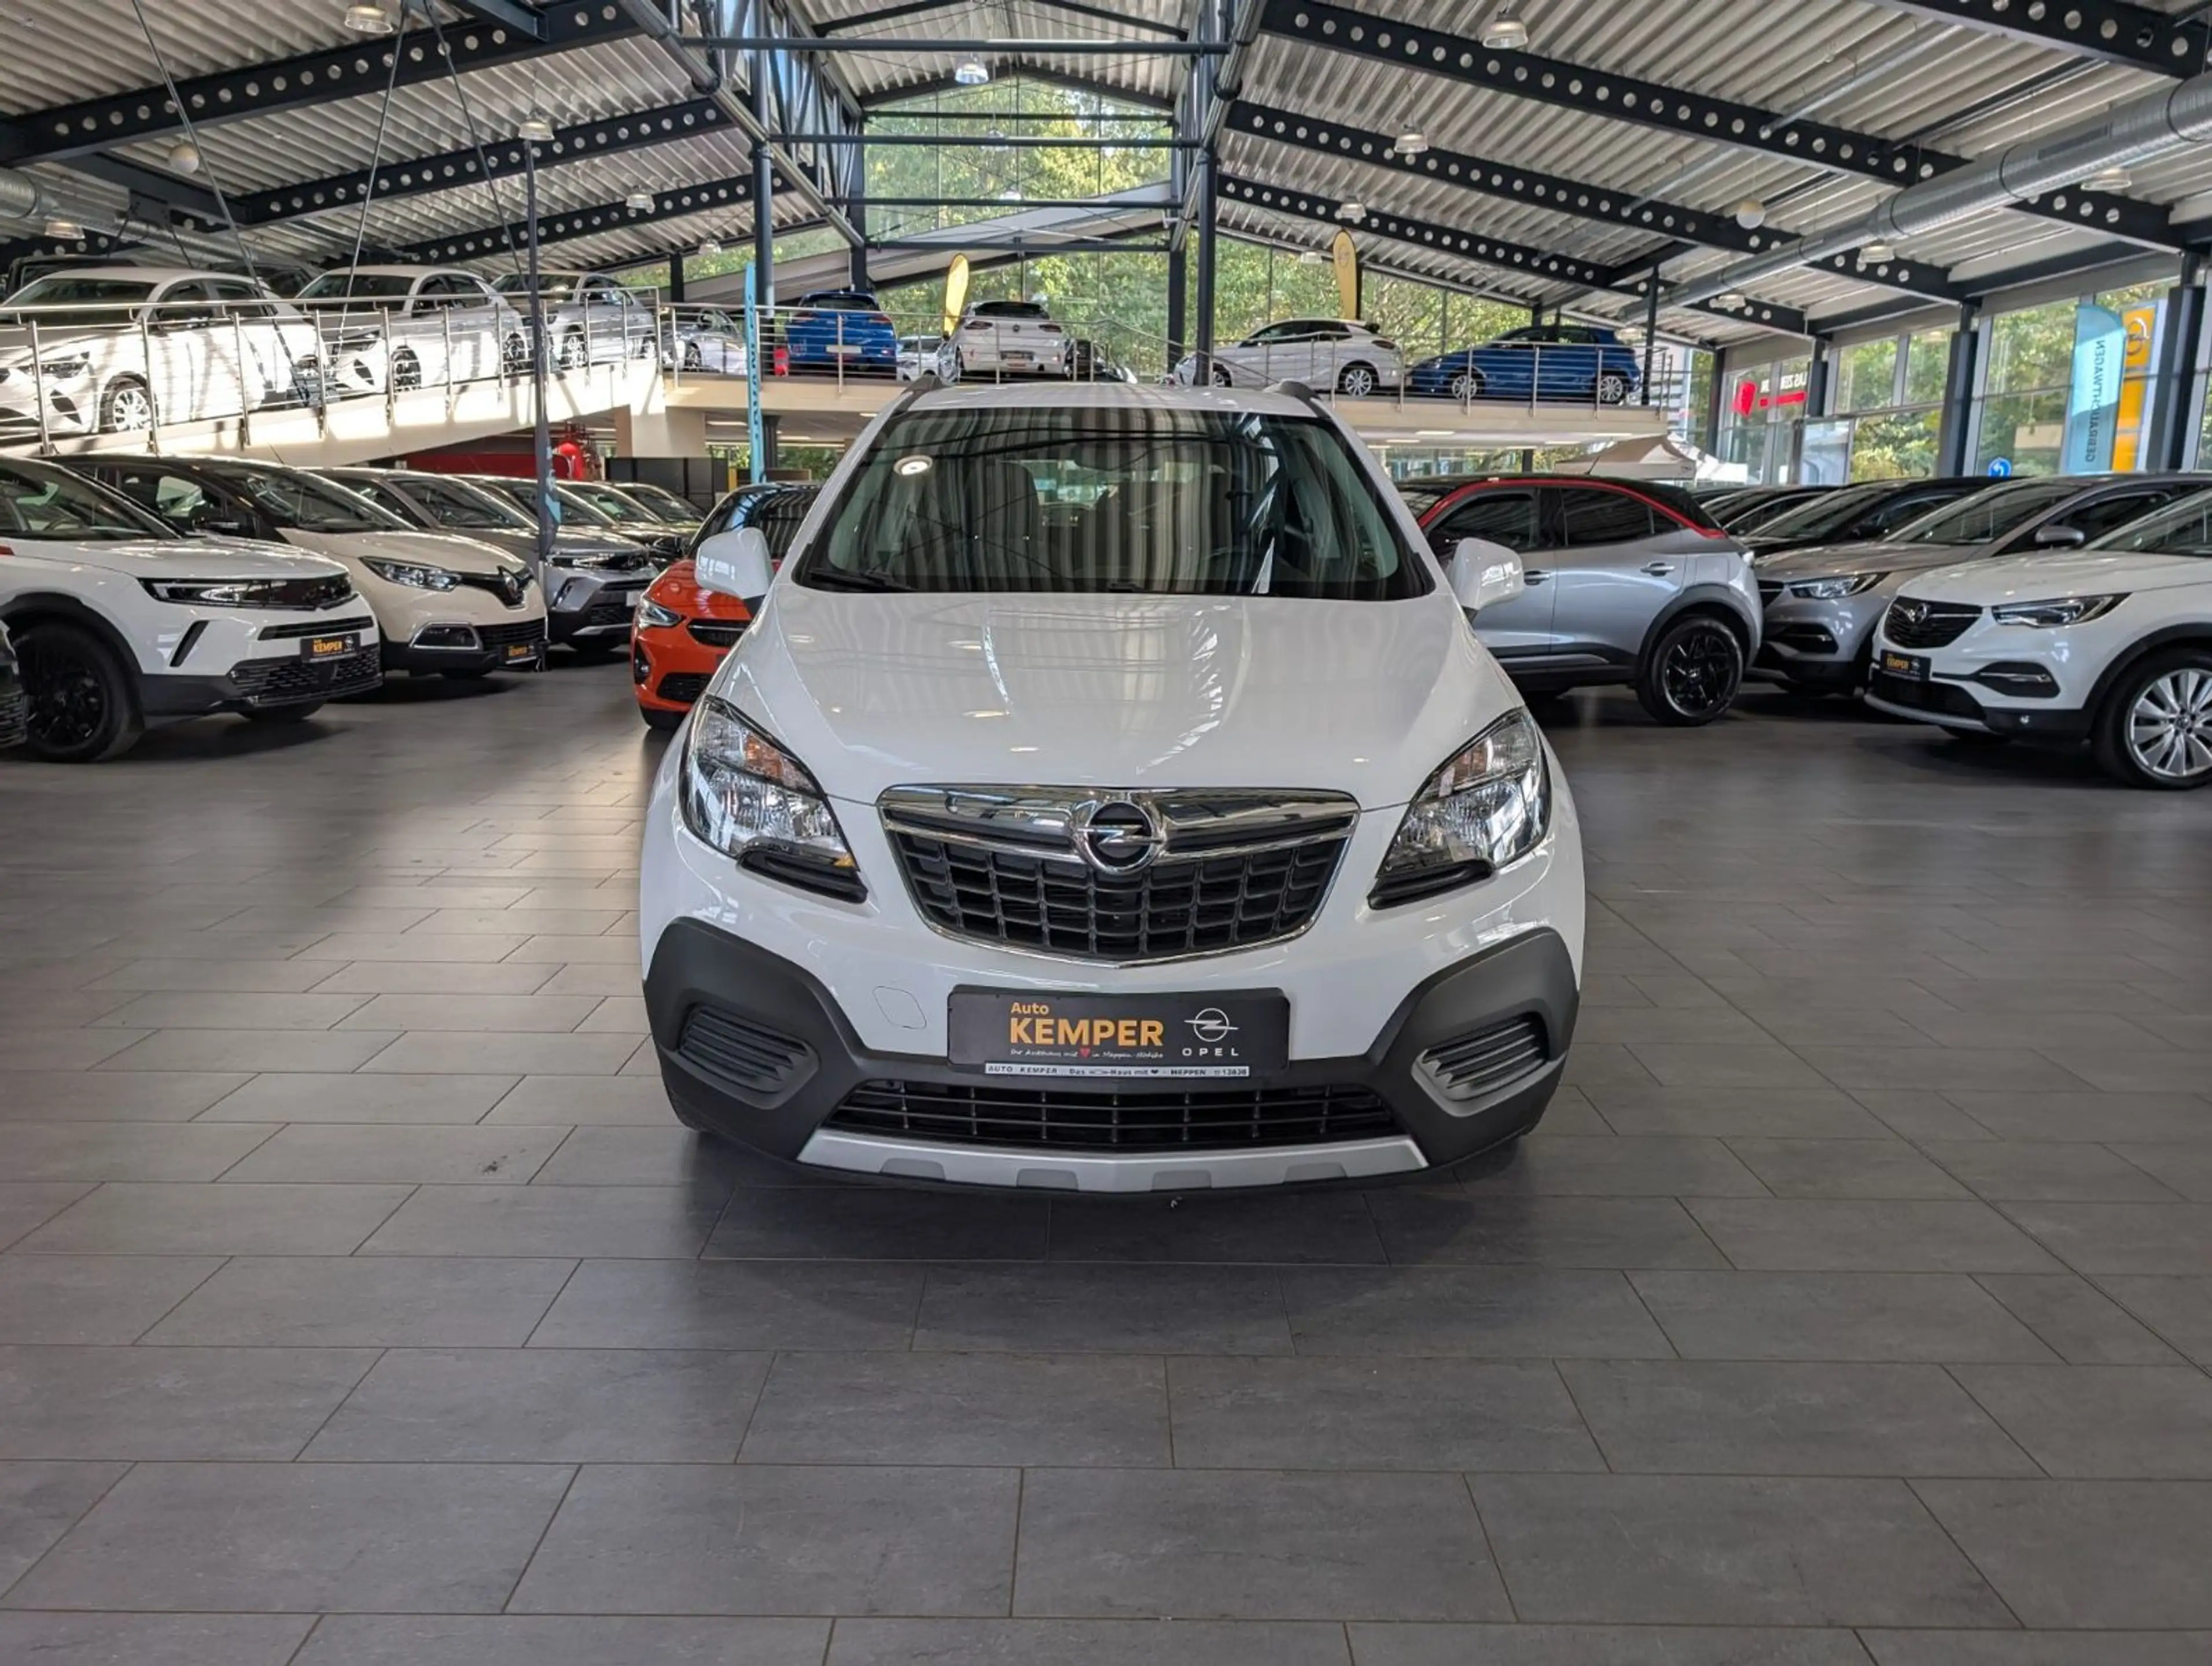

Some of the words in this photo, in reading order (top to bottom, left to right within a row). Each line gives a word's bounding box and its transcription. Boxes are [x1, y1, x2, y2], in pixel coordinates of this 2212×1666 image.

[1011, 1002, 1050, 1015] Auto
[1010, 1018, 1164, 1046] KEMPER
[1182, 1048, 1239, 1056] OPEL
